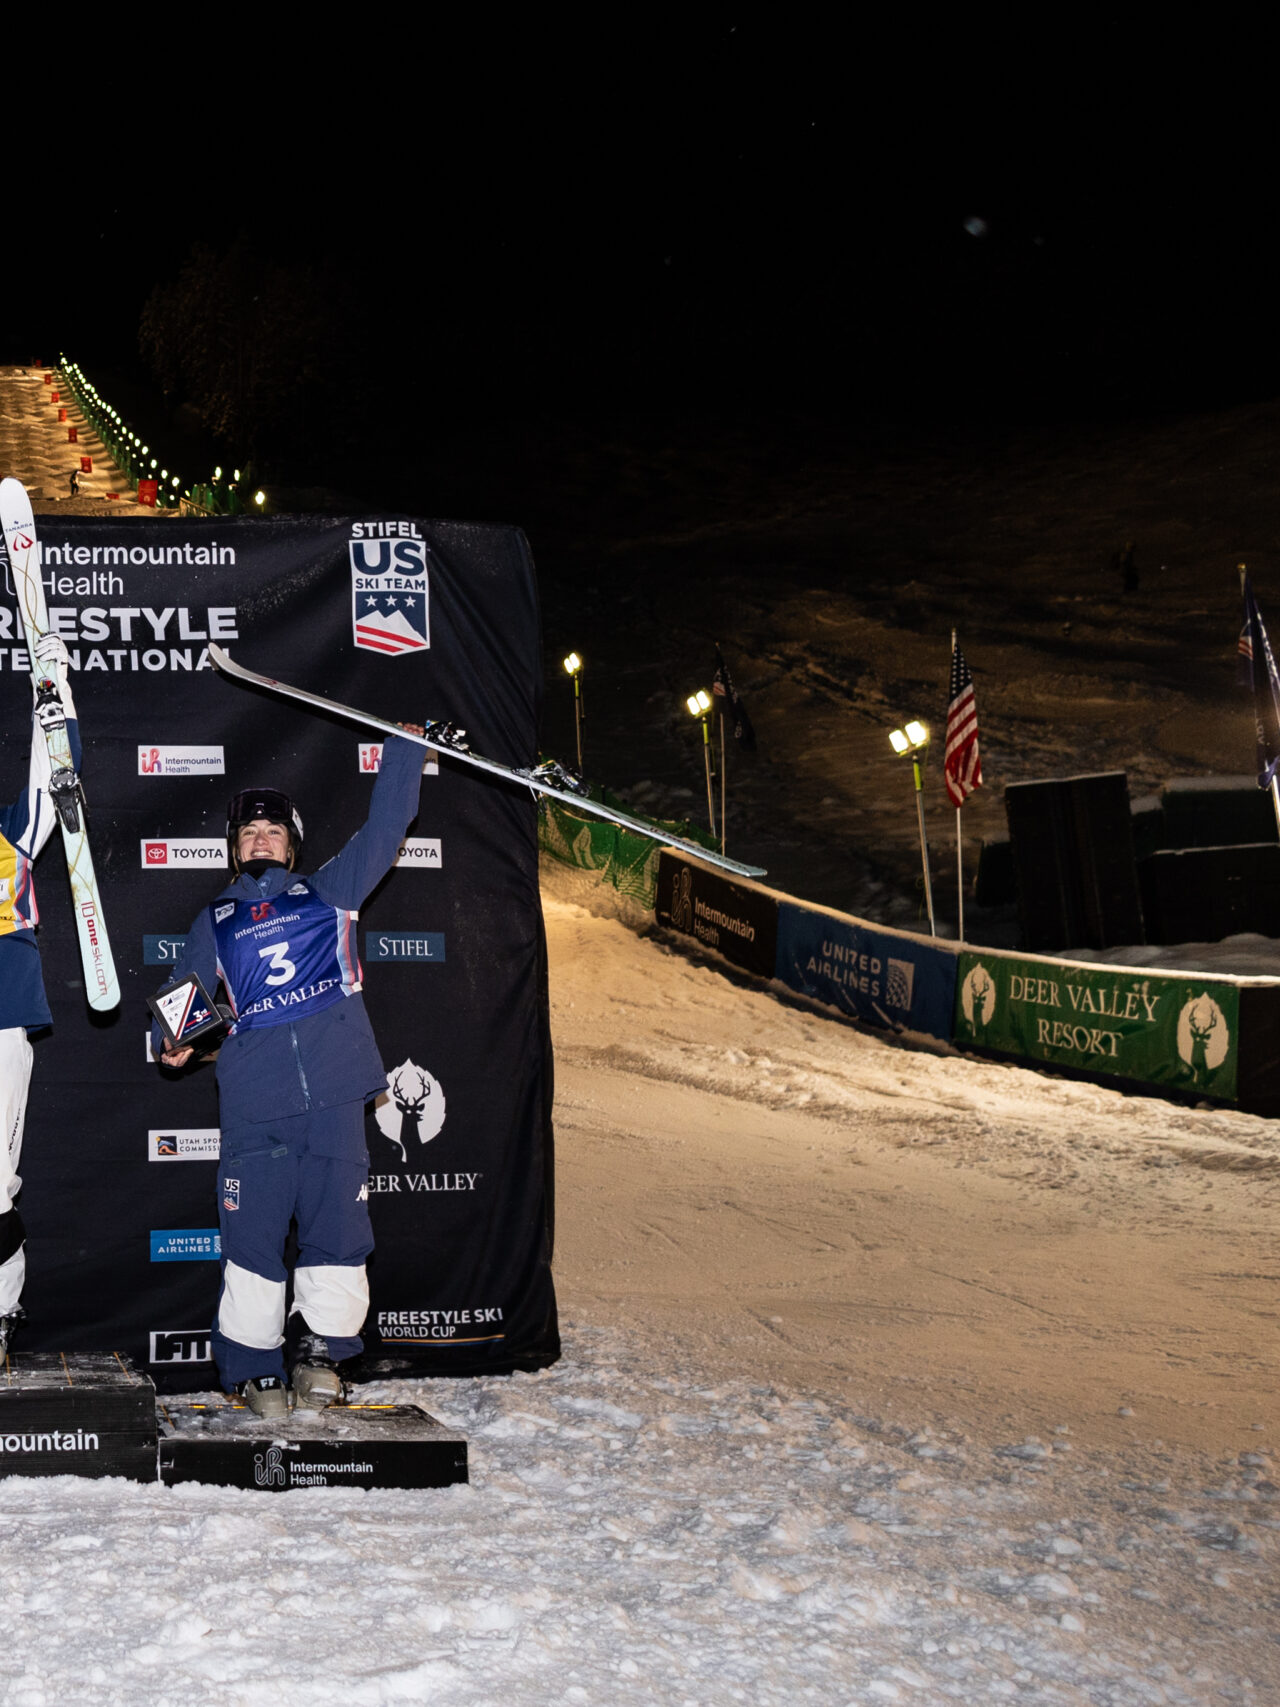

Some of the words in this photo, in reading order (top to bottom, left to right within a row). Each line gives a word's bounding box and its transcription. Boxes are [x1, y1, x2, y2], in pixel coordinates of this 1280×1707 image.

[351, 521, 422, 539] STIFEL
[352, 541, 425, 576] US
[356, 578, 379, 589] SKI
[384, 578, 426, 591] TEAM
[165, 756, 222, 765] Intermountain
[165, 765, 190, 774] Health
[172, 848, 224, 859] TOYOTA
[398, 848, 438, 859] OYOTA
[235, 913, 300, 940] Intermountain
[694, 896, 755, 943] Intermountain
[254, 924, 284, 940] Health
[694, 918, 719, 946] Health
[379, 937, 433, 957] STIFEL
[258, 941, 296, 986] 3
[823, 940, 882, 974] UNITED
[807, 956, 881, 998] AIRLINES
[1010, 975, 1062, 1009] DEER
[1066, 984, 1160, 1022] VALLEY
[1037, 1018, 1124, 1058] RESORT
[179, 1145, 220, 1153] COMMISSI
[224, 1179, 239, 1191] US
[368, 1174, 402, 1193] EER
[405, 1172, 478, 1192] VALLEY
[158, 1245, 211, 1254] AIRLINES
[168, 1237, 211, 1245] UNITED
[378, 1309, 470, 1325] FREESTYLE
[473, 1307, 503, 1323] SKI
[379, 1326, 428, 1338] WORLD
[431, 1326, 456, 1338] CUP
[290, 1461, 373, 1474] Intermountain
[290, 1474, 327, 1486] Health
